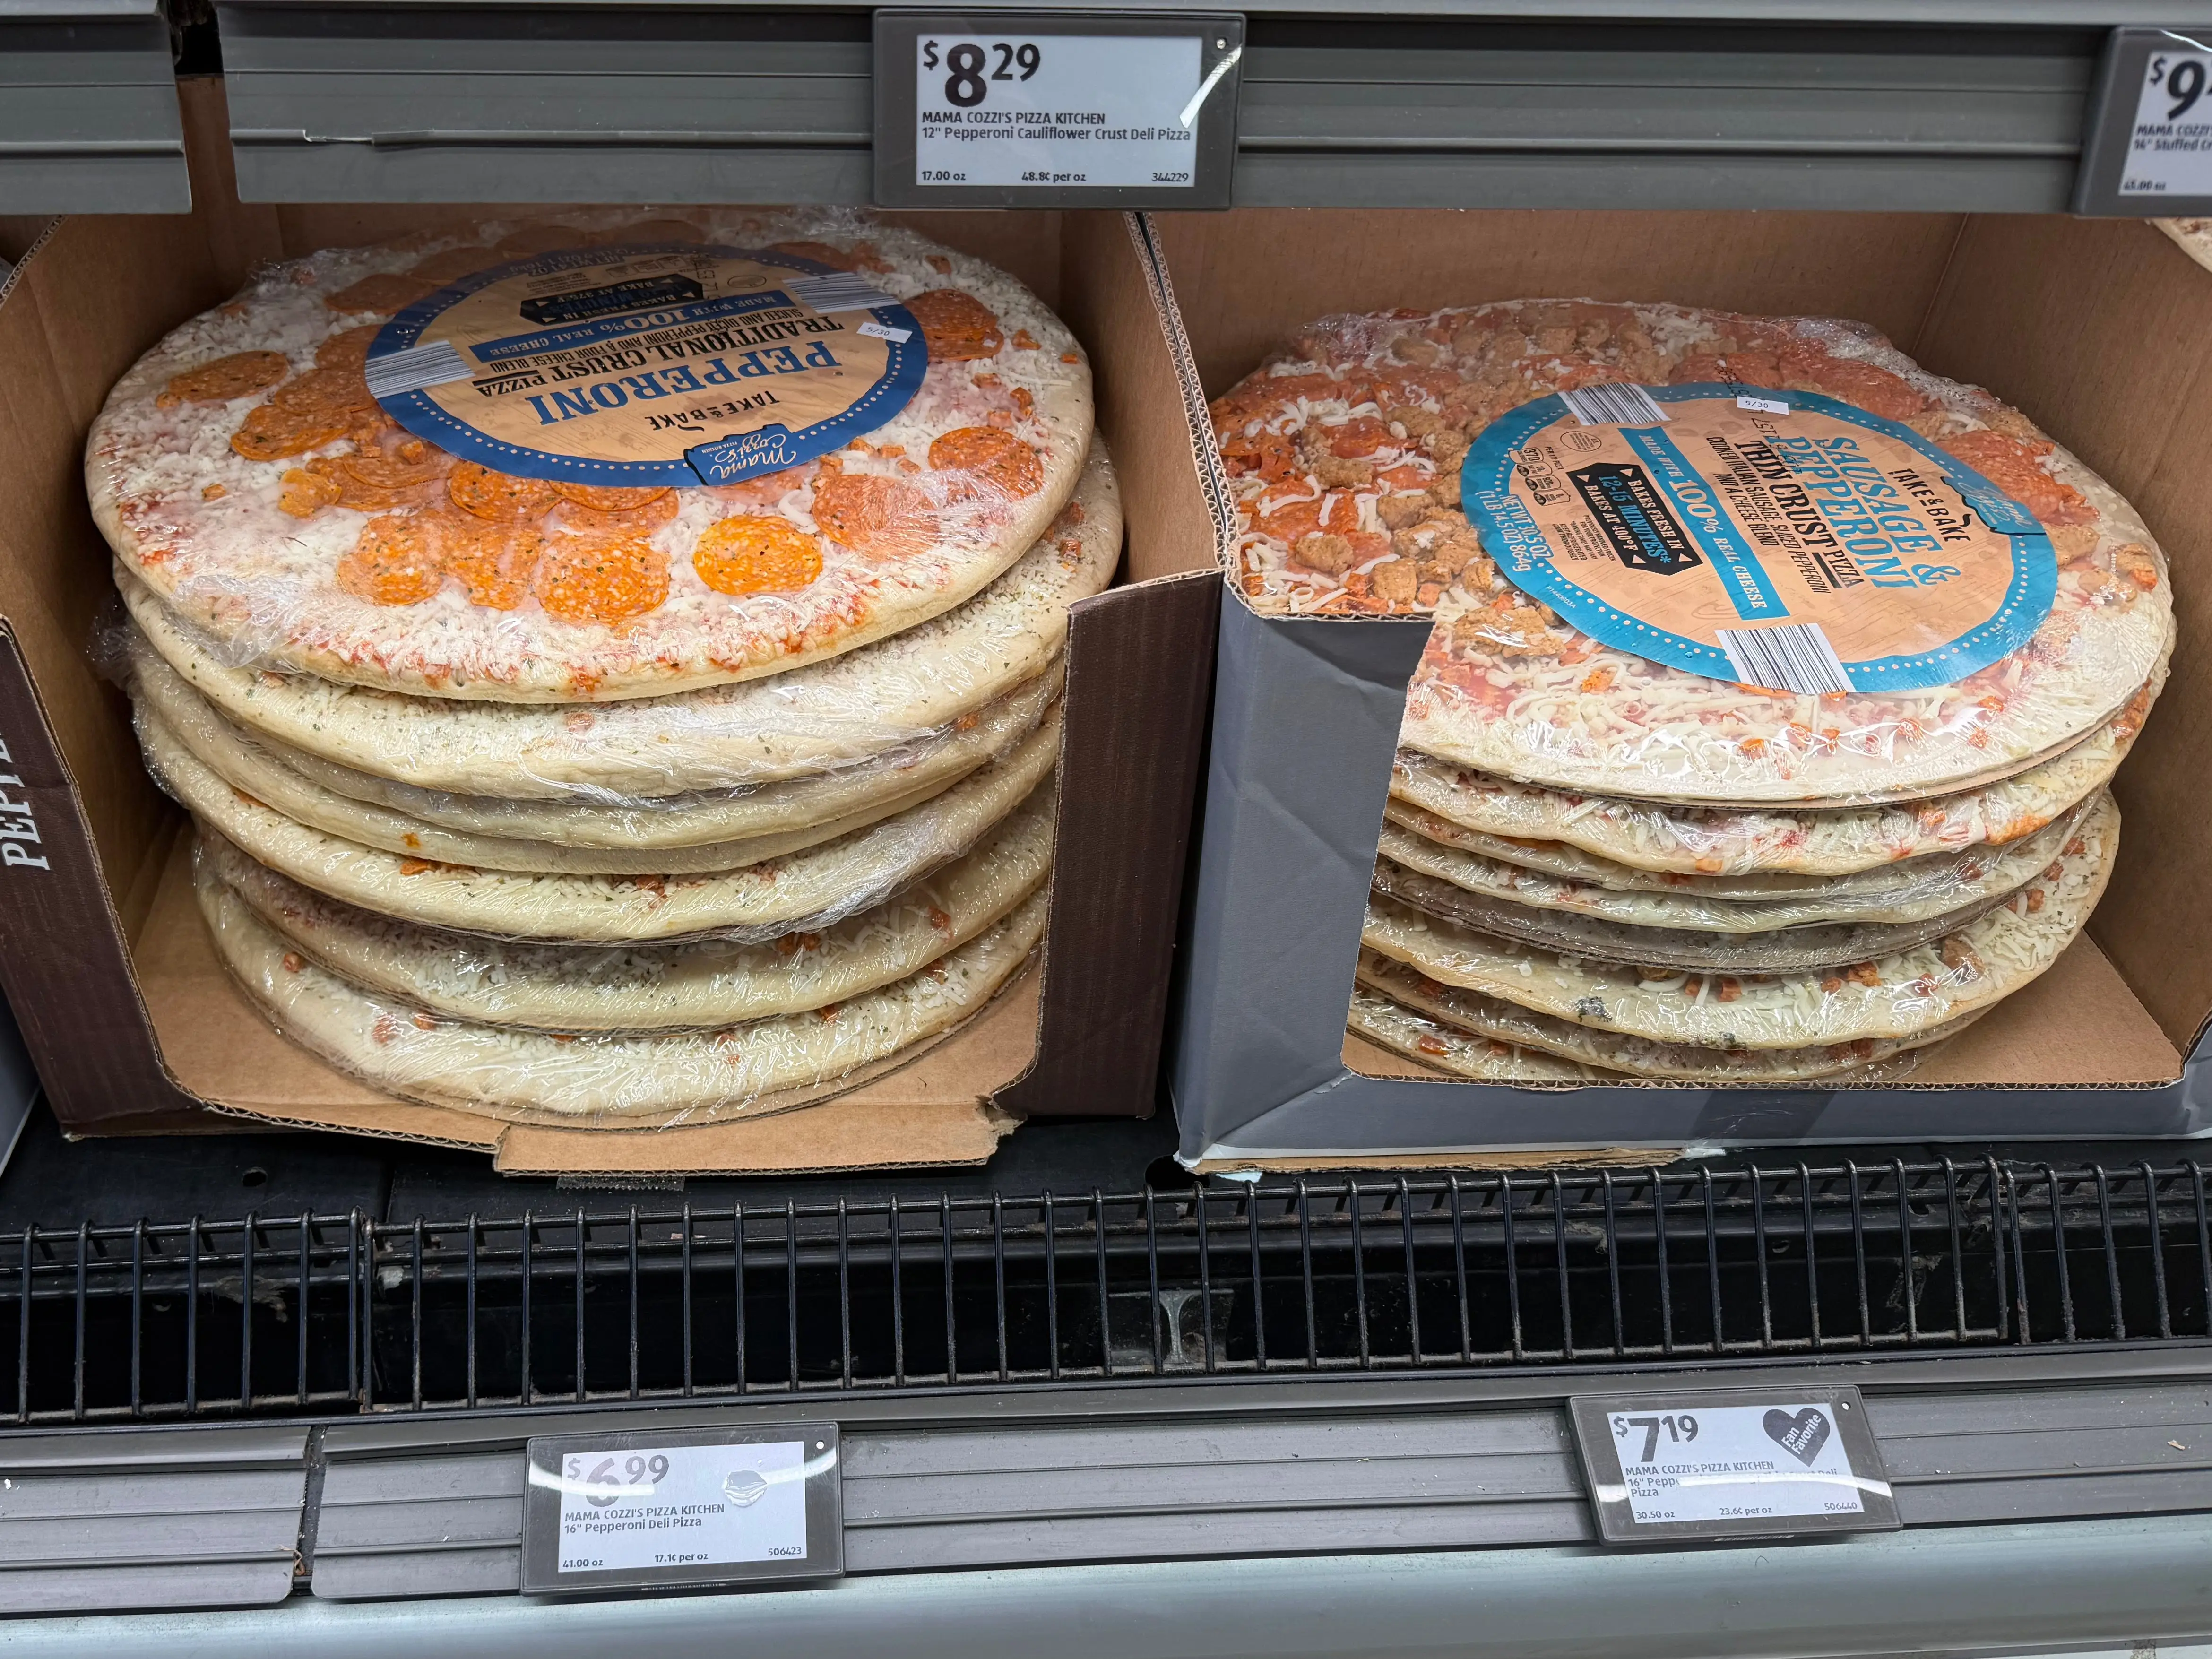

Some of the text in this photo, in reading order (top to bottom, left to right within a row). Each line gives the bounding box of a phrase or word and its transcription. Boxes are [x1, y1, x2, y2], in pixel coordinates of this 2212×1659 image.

[923, 112, 1105, 124] MAMA COZZI'S PIZZA KITCHEN
[923, 127, 1190, 142] 12" Pepperoni Cauliflower Crust Deli Pizza
[2137, 124, 2172, 137] MAMA
[2154, 139, 2198, 151] Stuffed
[2200, 140, 2212, 151] Cr
[922, 171, 950, 181] 17.00
[953, 173, 966, 181] oz
[1022, 172, 1050, 182] 48.8¢
[1054, 173, 1071, 183] per
[1152, 173, 1189, 182] 344229
[617, 280, 655, 294] BAKE
[563, 312, 580, 320] IN
[738, 313, 765, 326] AND
[764, 309, 804, 320] SLICED
[490, 296, 776, 355] MADE WITH 100% REAL CHEESE
[866, 327, 890, 336] 5/30
[617, 337, 643, 349] AND
[642, 325, 704, 345] PEPPERONI
[575, 346, 607, 358] FOUR
[606, 341, 617, 351] A
[475, 316, 845, 397] TRADITIONAL CRUST PIZZA
[529, 352, 575, 367] CHEESE
[490, 359, 530, 373] BLEND
[525, 341, 842, 425] PEPPERONI
[715, 434, 786, 463] Cozzi's
[1523, 448, 1540, 462] 370
[710, 448, 796, 479] Mama
[1599, 475, 1633, 502] 12-15
[1483, 500, 1503, 510] LB
[1584, 484, 1613, 512] BAKES
[1887, 468, 1935, 498] TAKE
[1926, 508, 1971, 542] BAKE
[1602, 512, 1622, 524] AT
[1628, 479, 1685, 550] BAKES FRESH IN
[1706, 437, 1740, 460] COOKED
[1726, 460, 1761, 485] ITALIAN
[1771, 524, 1802, 549] SLICED
[1788, 551, 1832, 594] PEPPERONI
[1713, 473, 1739, 486] AND
[1729, 495, 1763, 522] CHEESE
[1747, 524, 1780, 546] BLEND
[1733, 440, 1793, 480] THIN
[1769, 484, 1838, 548] CRUST
[1823, 549, 1865, 588] PIZZA
[1763, 436, 1919, 588] PEPPERONI
[1812, 437, 1961, 586] SAUSAGE &
[1490, 511, 1514, 529] 14.5
[1500, 494, 1552, 560] NET WT 30.5 OZ
[1638, 435, 1768, 609] MADE WITH 100% REAL CHEESE
[1501, 529, 1523, 544] OZ)
[1611, 525, 1639, 551] 400°F
[1509, 545, 1532, 572] 864g
[1782, 1426, 1799, 1448] Fan
[1792, 1413, 1821, 1455] Favorite
[1625, 1460, 1774, 1476] MAMA COZZI'S PIZZA KITCHEN
[1628, 1478, 1644, 1488] 16"
[1632, 1487, 1659, 1498] Pizza
[565, 1503, 725, 1522] MAMA COZZI'S PIZZA KITCHEN
[1637, 1511, 1661, 1519] 30.50
[1744, 1508, 1759, 1516] per
[1824, 1502, 1857, 1511] 506440
[565, 1515, 702, 1534] 16" Pepperoni Deli Pizza
[562, 1558, 589, 1568] 41.00
[655, 1554, 677, 1563] 17.1¢
[679, 1555, 694, 1564] per
[768, 1547, 802, 1556] 506423
